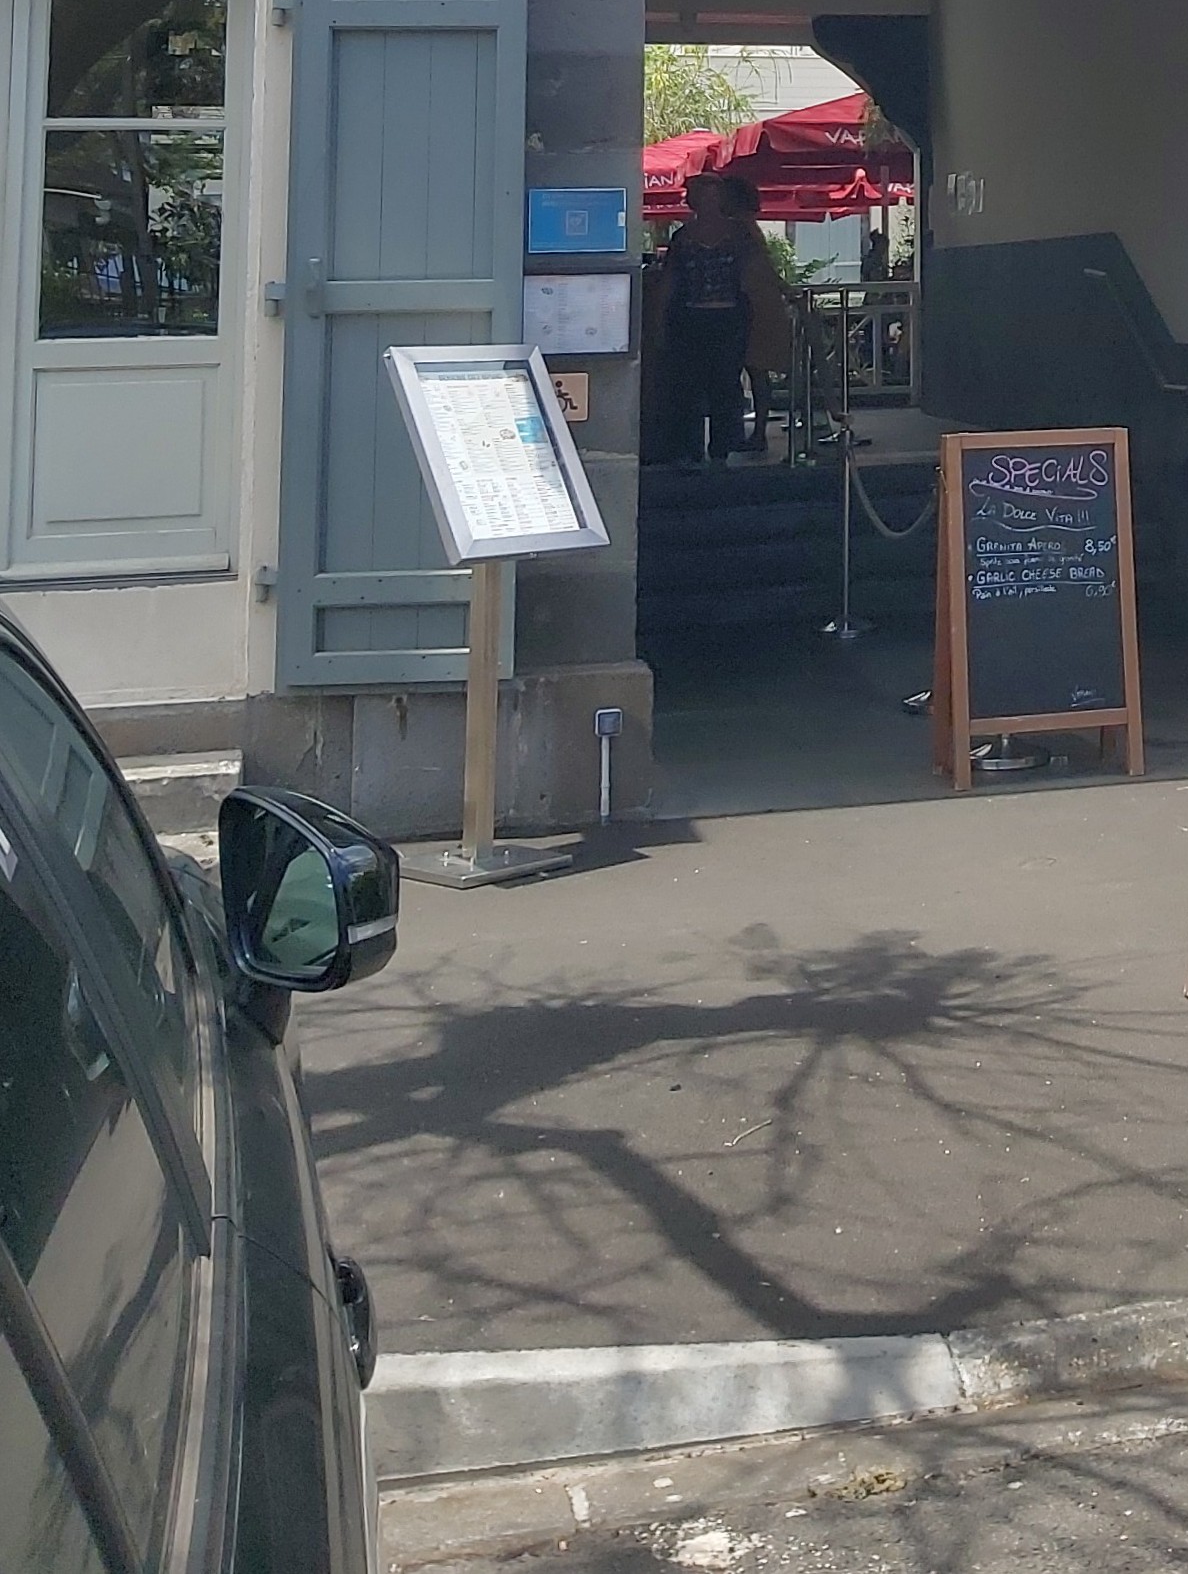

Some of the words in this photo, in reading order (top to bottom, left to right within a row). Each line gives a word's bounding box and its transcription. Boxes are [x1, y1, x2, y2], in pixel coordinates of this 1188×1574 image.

[976, 570, 1017, 585] GARLIC
[1021, 567, 1063, 582] CHEESE
[1069, 566, 1106, 579] BREAD
